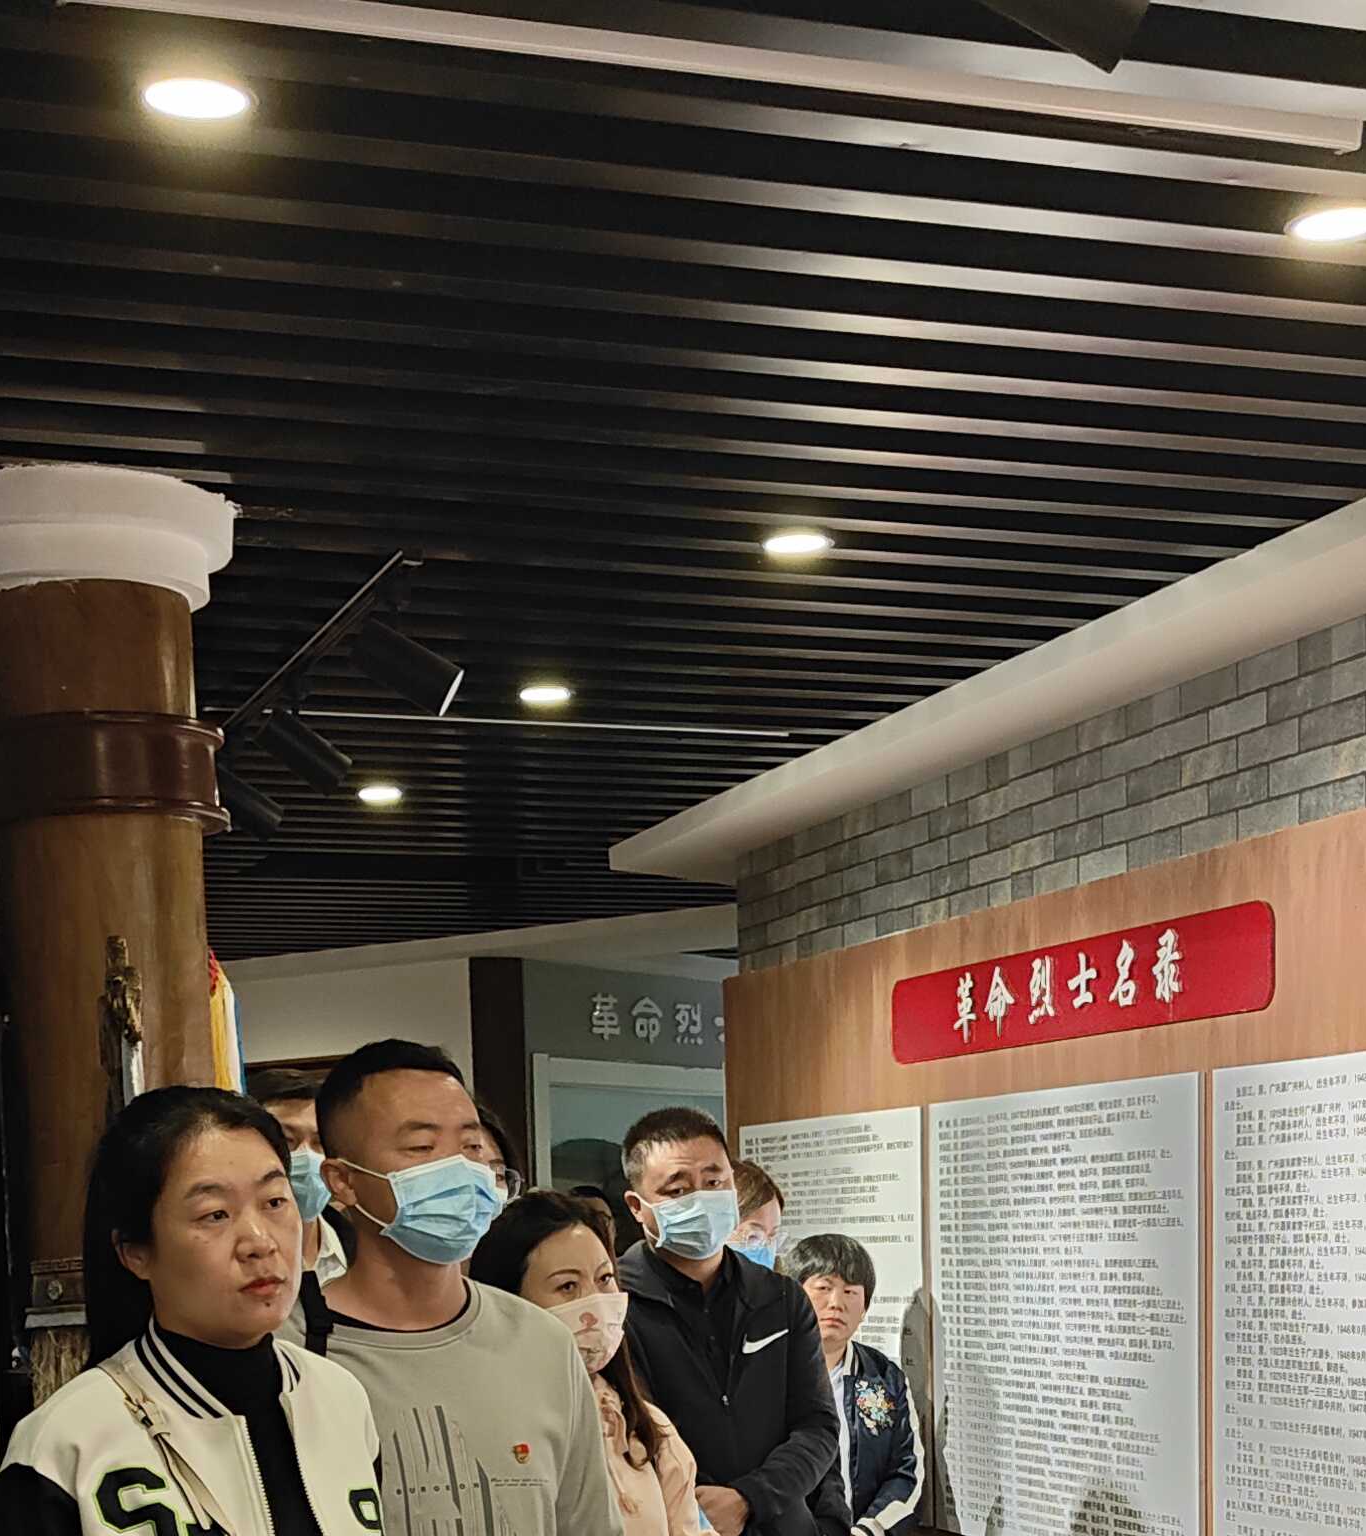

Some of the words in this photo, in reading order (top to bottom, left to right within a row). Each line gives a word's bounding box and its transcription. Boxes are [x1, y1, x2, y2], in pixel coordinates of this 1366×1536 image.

[591, 993, 725, 1045] 革命烈
[953, 927, 1182, 1044] 革命烈士名录
